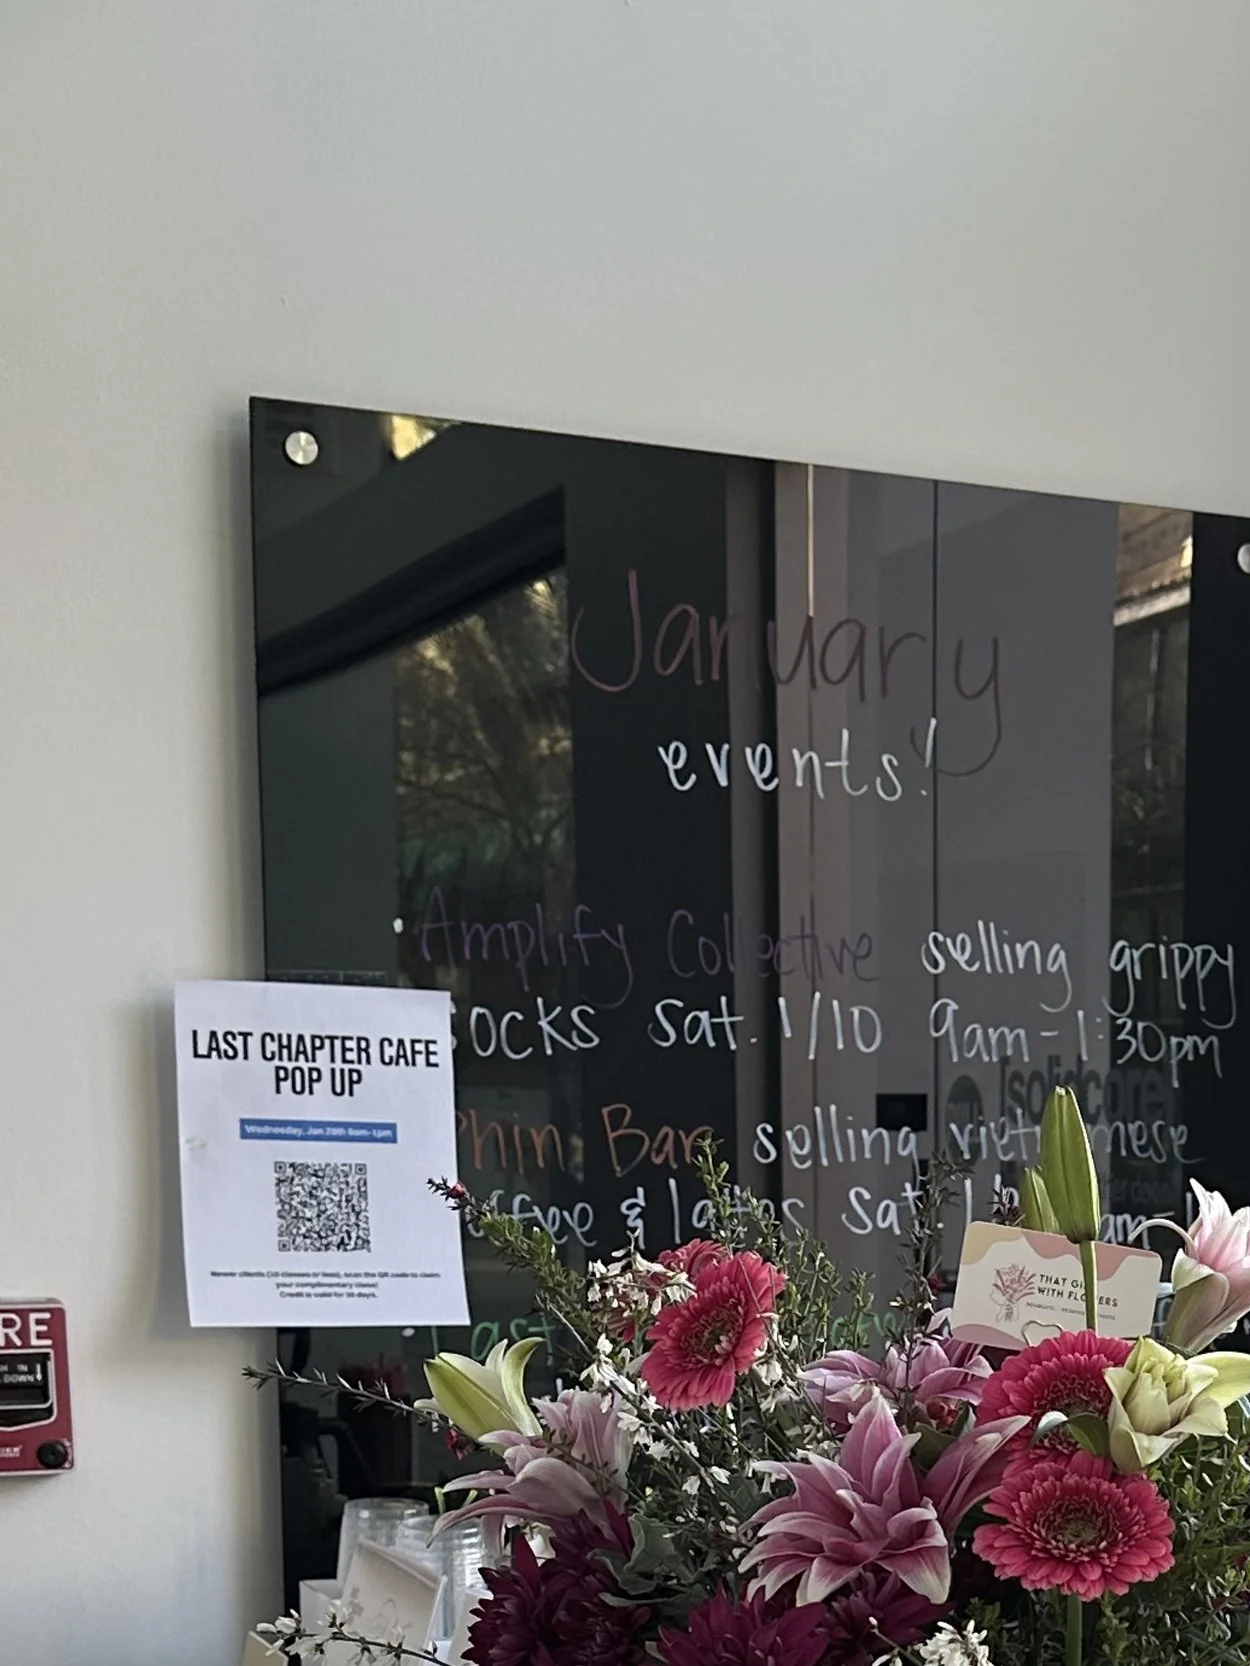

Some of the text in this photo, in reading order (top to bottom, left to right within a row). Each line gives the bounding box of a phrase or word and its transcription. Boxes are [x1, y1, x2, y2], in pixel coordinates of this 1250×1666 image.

[568, 568, 1001, 778] January
[657, 716, 937, 802] events!
[420, 886, 1237, 1029] Amplify Collective selling grippy
[191, 1029, 440, 1068] LAST CHAPTER CAFE
[449, 995, 600, 1061] ocks
[778, 990, 883, 1061] 1/10
[274, 1066, 363, 1097] POP UP
[458, 1108, 567, 1175] hin
[601, 1103, 716, 1178] Bar
[752, 1103, 922, 1184] selling
[619, 1185, 647, 1250] &
[1037, 1286, 1119, 1308] WITH FLOERS
[1039, 1274, 1067, 1289] THAT
